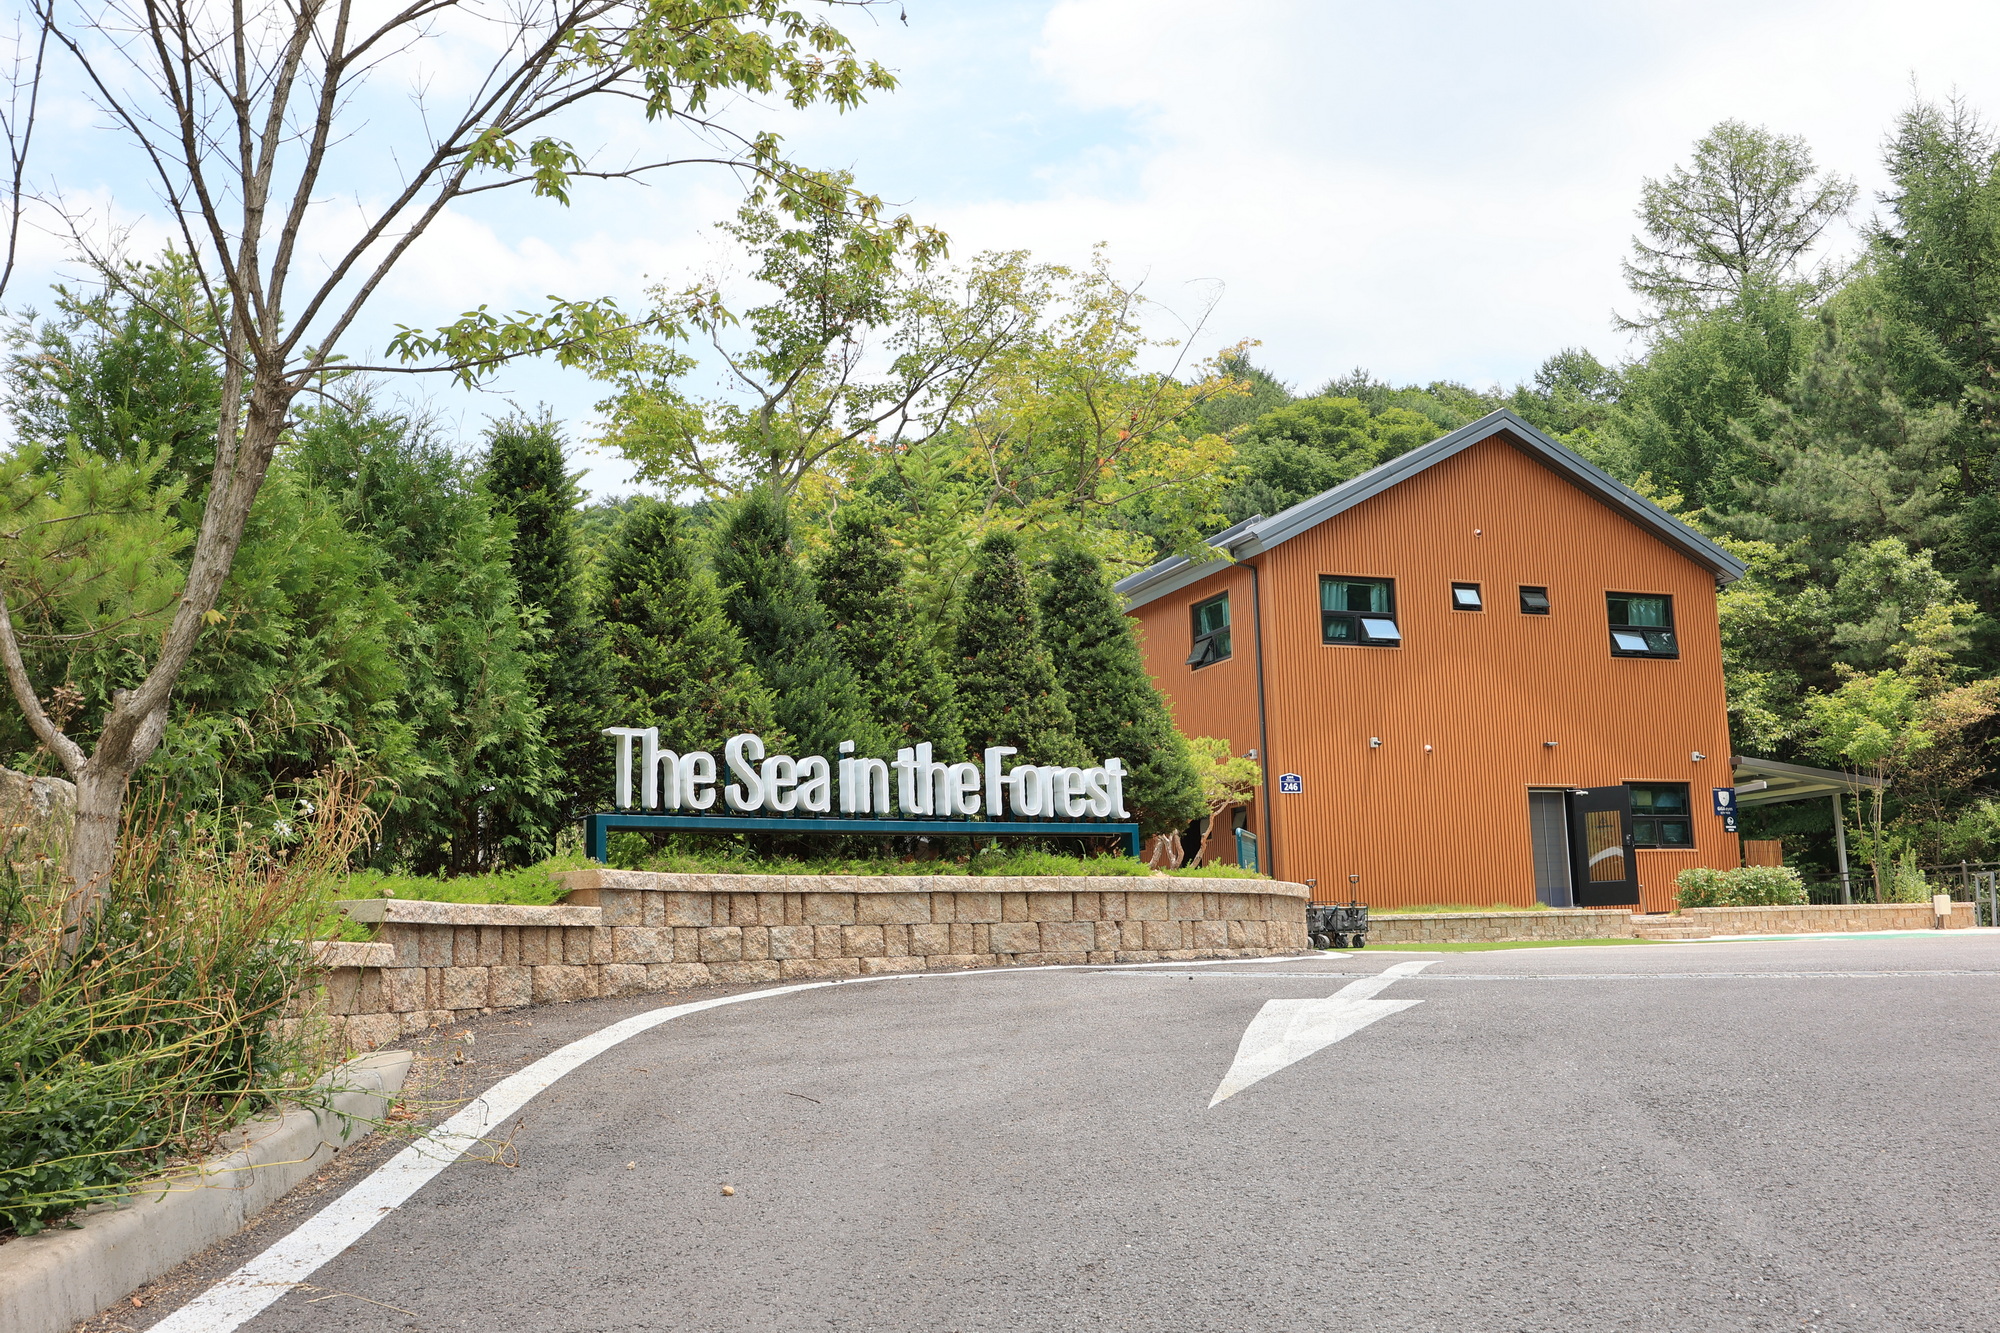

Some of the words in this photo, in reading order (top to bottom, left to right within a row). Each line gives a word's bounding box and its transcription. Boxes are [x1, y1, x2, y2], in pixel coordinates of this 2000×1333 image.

[602, 726, 716, 810] The
[724, 733, 831, 813] Sea
[839, 740, 889, 814] in
[892, 741, 980, 816] the
[985, 746, 1130, 819] Forest
[1284, 782, 1298, 791] 246
